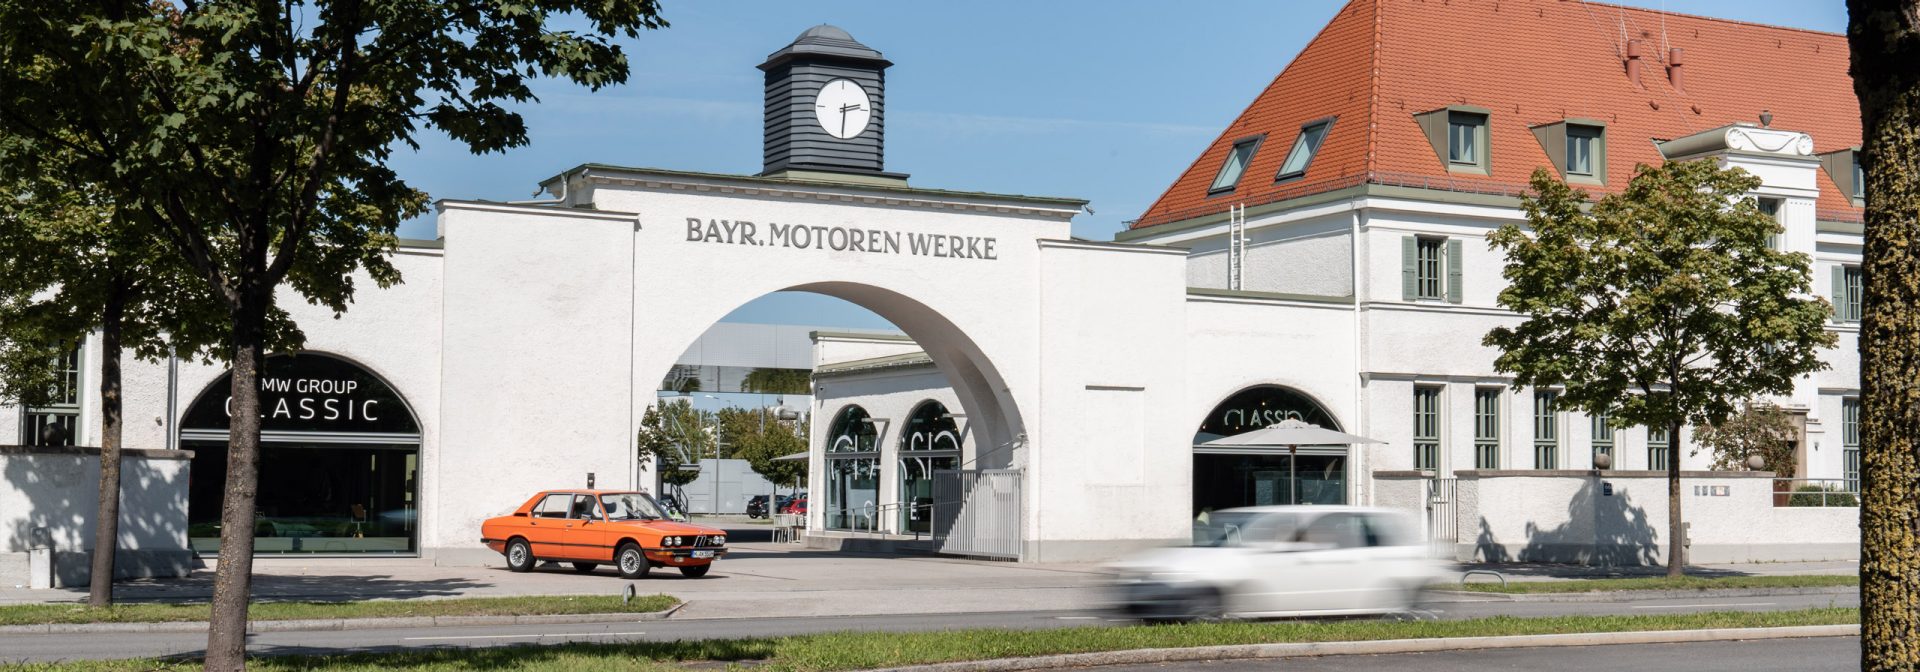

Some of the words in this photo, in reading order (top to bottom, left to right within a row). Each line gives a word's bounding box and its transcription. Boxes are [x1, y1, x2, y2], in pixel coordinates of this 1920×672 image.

[685, 217, 764, 246] BAYR.
[769, 222, 900, 254] MOTOREN
[907, 232, 997, 260] WERKE
[261, 377, 291, 392] MW
[296, 379, 357, 394] GROUP
[225, 397, 378, 421] CASSIC
